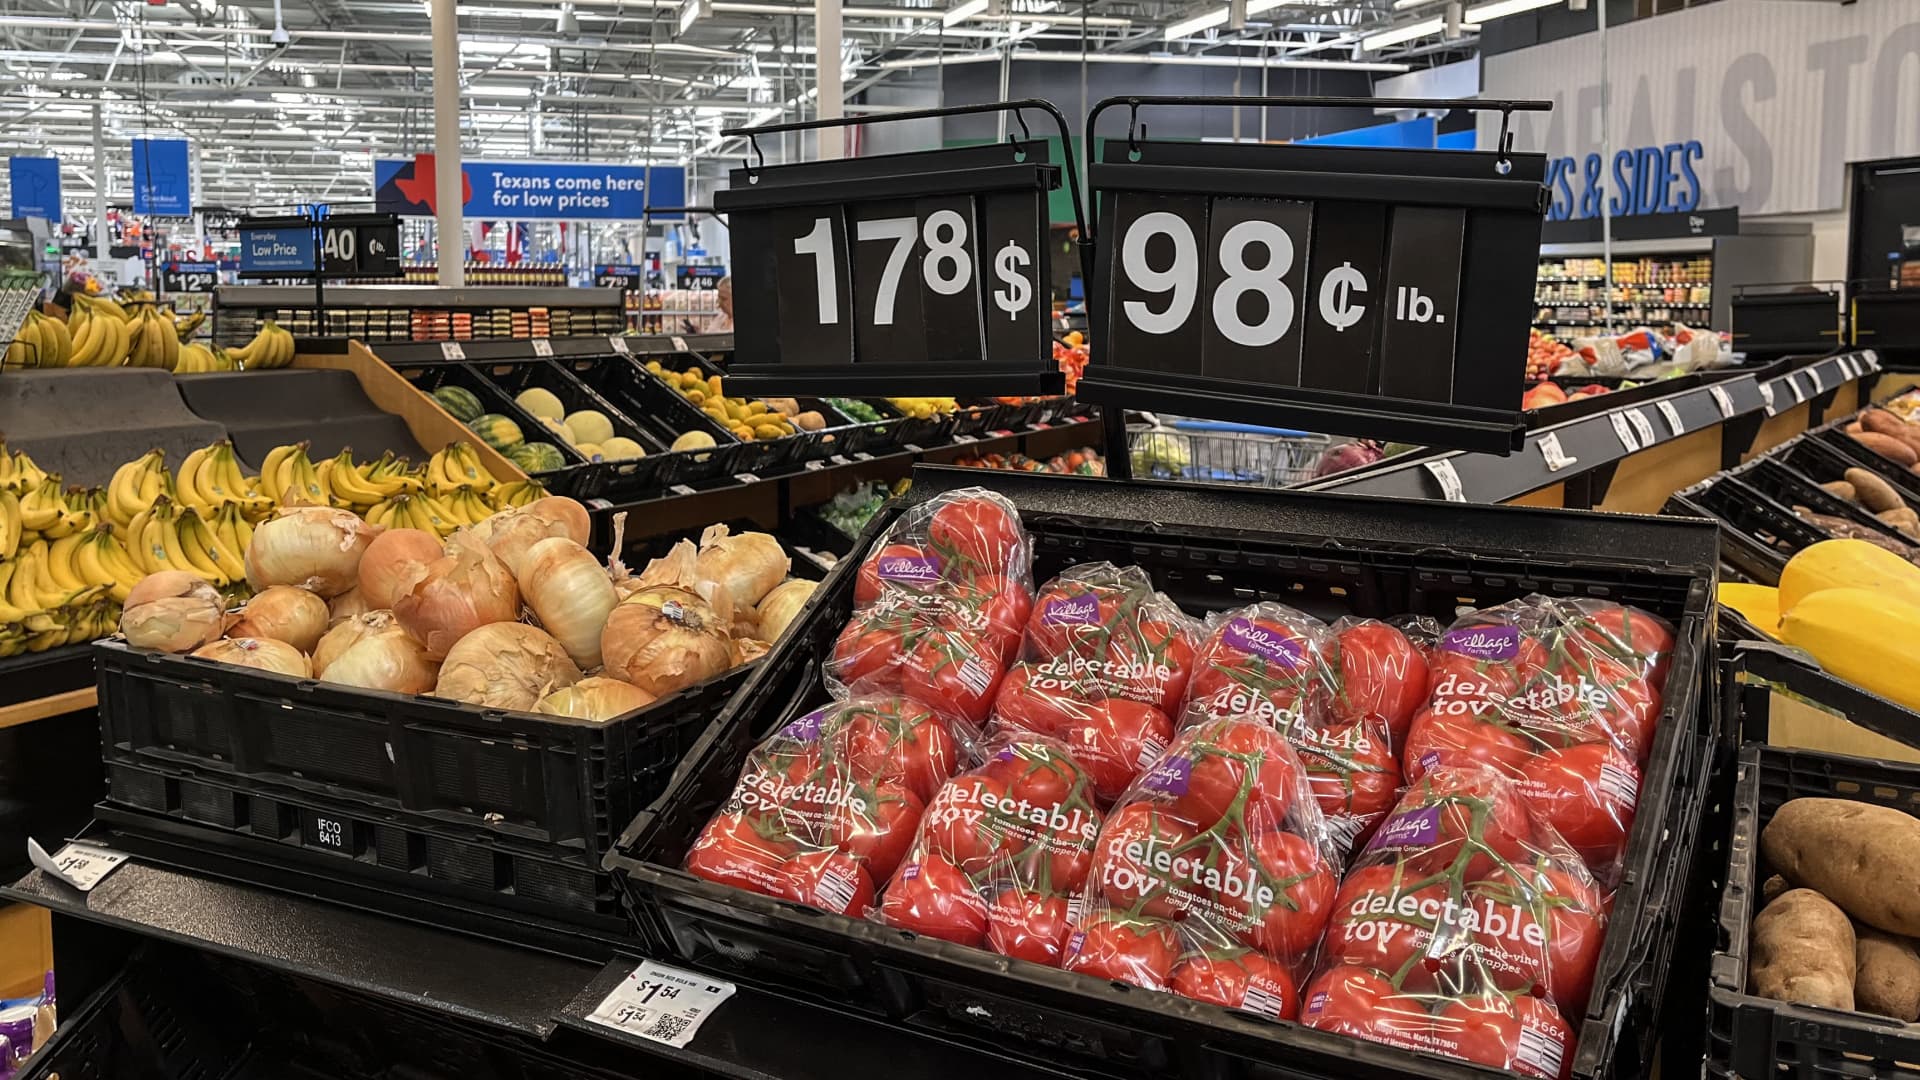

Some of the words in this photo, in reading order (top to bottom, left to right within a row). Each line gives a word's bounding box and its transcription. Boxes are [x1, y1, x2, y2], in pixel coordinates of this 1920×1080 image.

[492, 172, 550, 190] Texans
[555, 178, 600, 191] come
[606, 172, 645, 191] here
[1581, 153, 1605, 220] &
[1612, 140, 1704, 216] SIDES
[492, 190, 519, 207] for
[523, 190, 554, 208] low
[558, 191, 610, 211] prices
[252, 244, 271, 257] Low
[273, 243, 297, 256] Price
[324, 228, 355, 261] 40
[994, 239, 1032, 321] $
[1121, 211, 1294, 348] 98
[1318, 261, 1367, 332] ¢
[1397, 286, 1446, 325] lb.
[1037, 650, 1170, 681] delectable
[1432, 697, 1492, 716] tov
[1436, 674, 1609, 710] delectable
[317, 818, 341, 834] IFCO
[934, 781, 1098, 841] delectable
[993, 817, 1036, 836] tomatoes
[319, 831, 341, 847] 6413
[1103, 856, 1159, 897] tov
[1108, 827, 1274, 908] delectable
[1168, 886, 1212, 907] tomatoes
[1343, 918, 1403, 945] tov
[1350, 886, 1546, 946] delectable
